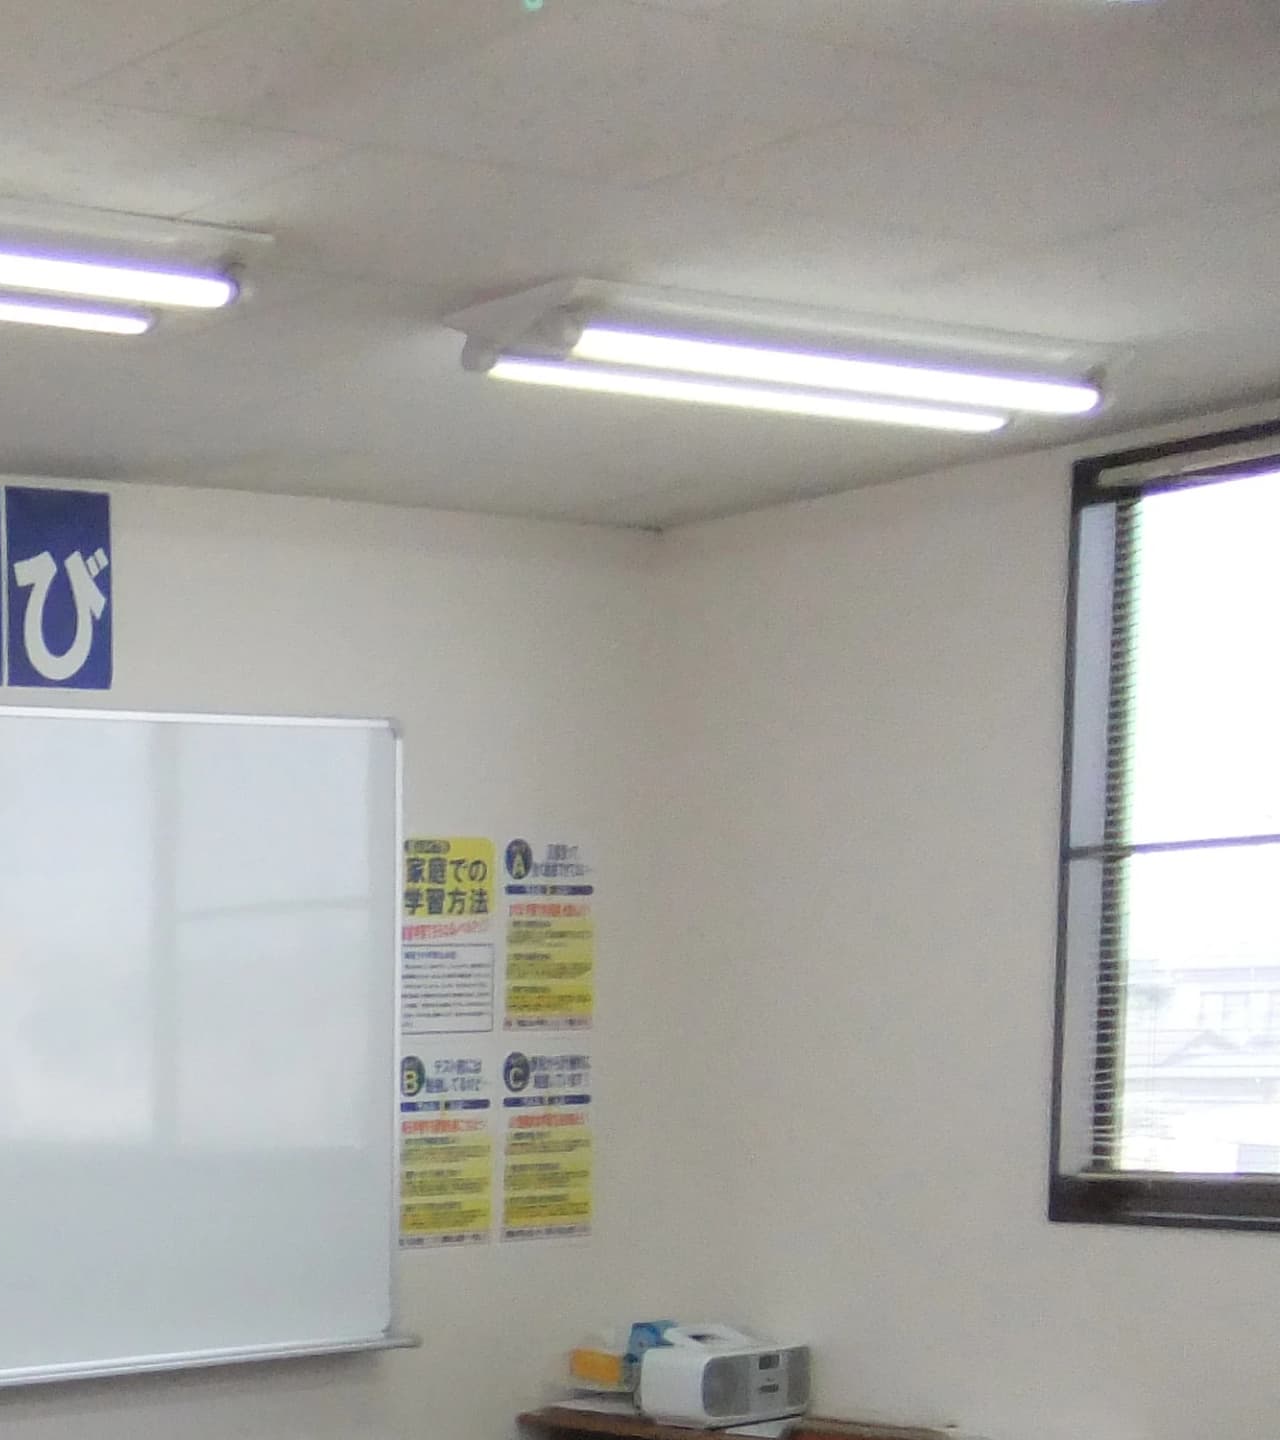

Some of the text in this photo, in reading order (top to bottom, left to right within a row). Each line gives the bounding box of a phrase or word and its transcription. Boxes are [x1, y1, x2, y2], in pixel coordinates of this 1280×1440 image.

[406, 857, 488, 884] 家庭での
[404, 888, 489, 915] 学習方法
